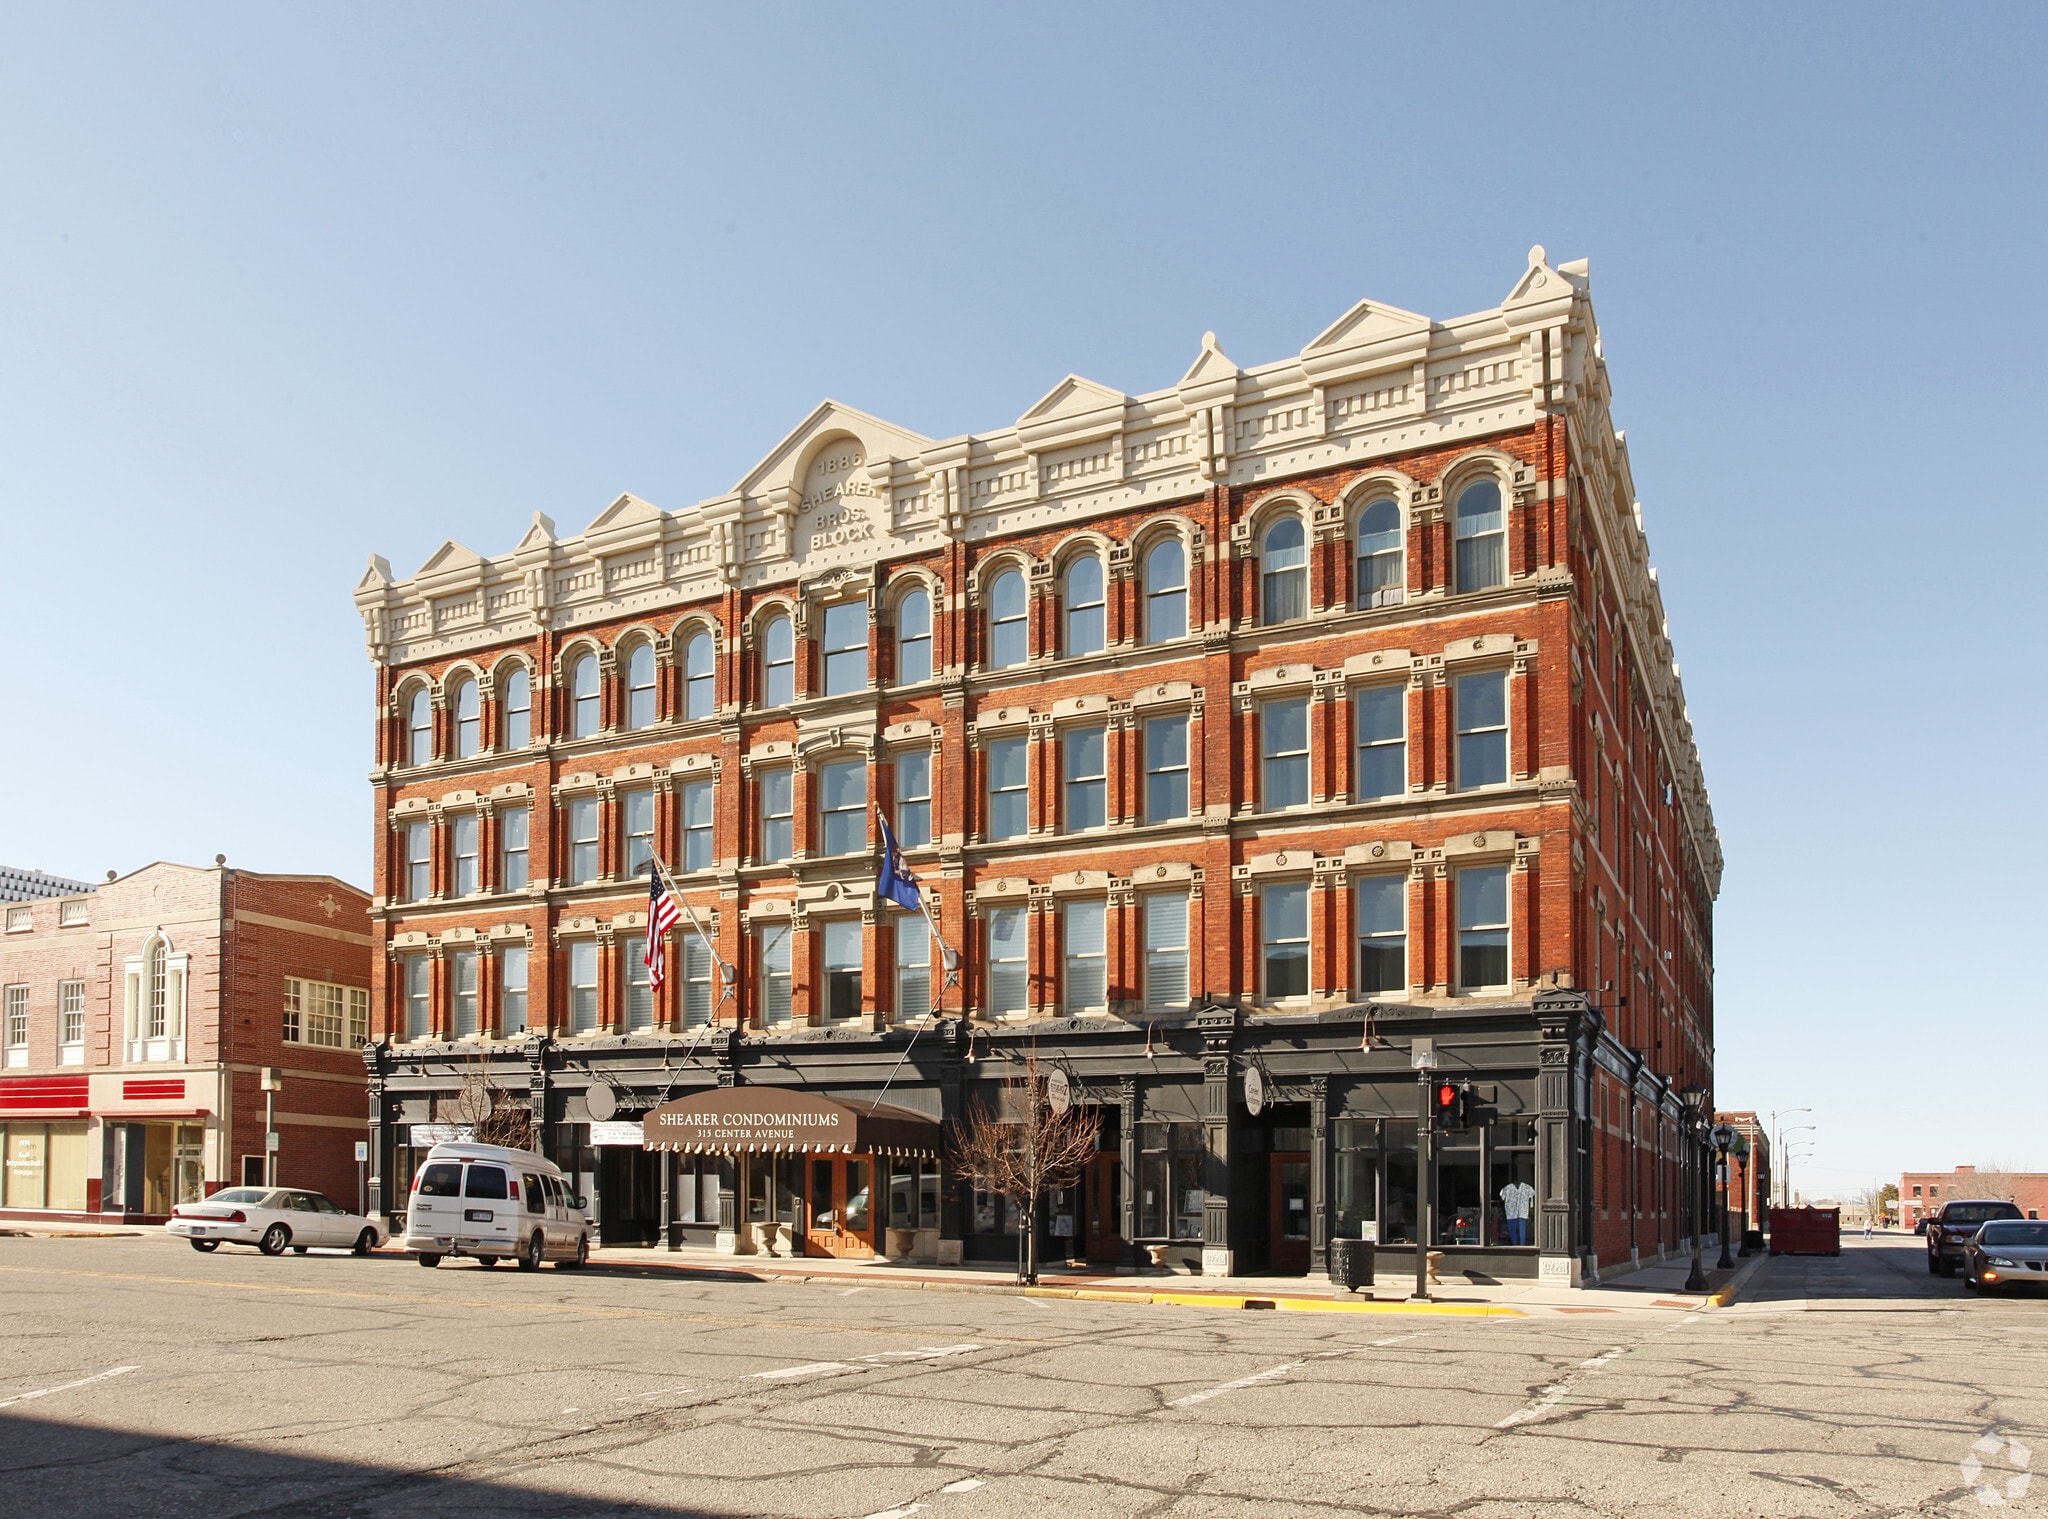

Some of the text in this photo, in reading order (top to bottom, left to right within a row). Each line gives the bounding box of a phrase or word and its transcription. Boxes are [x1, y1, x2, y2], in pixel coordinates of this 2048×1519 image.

[818, 452, 863, 476] 1886
[810, 523, 871, 550] BLOCK
[659, 1113, 719, 1126] SHEARER
[722, 1113, 839, 1127] CONDOMINIUMS
[697, 1129, 794, 1138] 315 CENTER AVENUE
